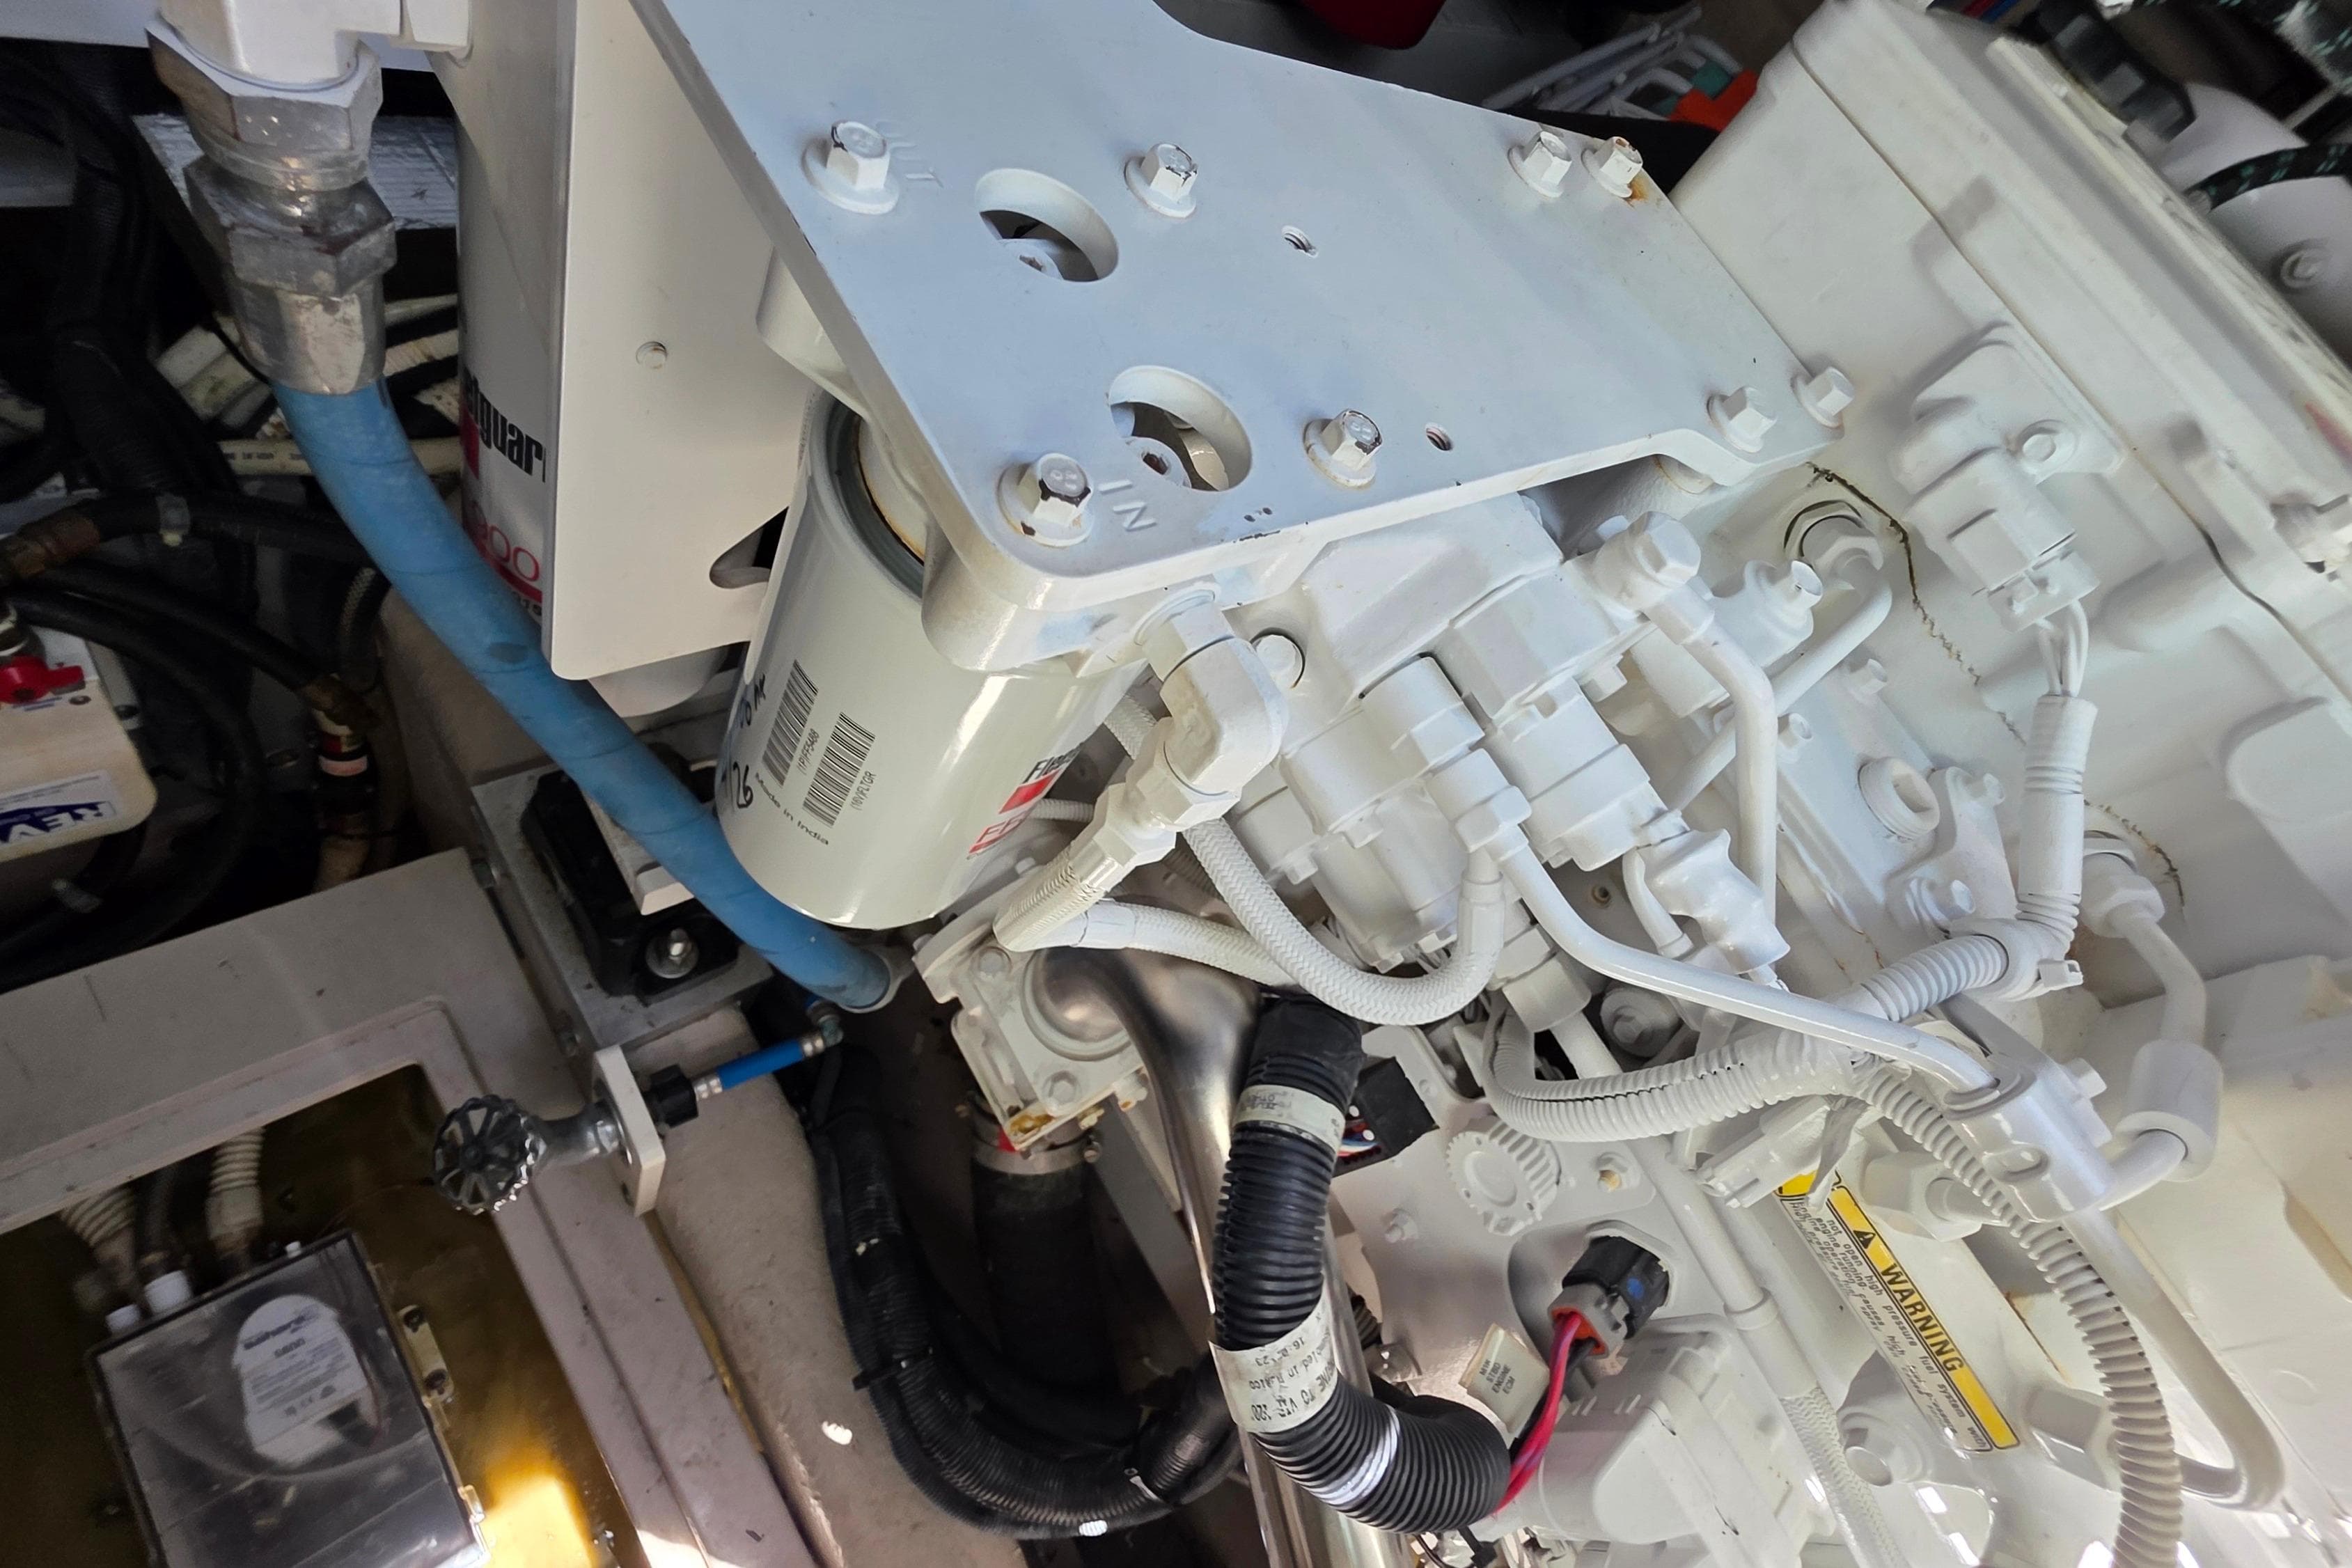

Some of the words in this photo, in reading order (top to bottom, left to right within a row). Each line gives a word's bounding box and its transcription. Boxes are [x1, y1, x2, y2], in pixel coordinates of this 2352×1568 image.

[1098, 478, 1158, 532] IN
[755, 771, 781, 808] Made
[783, 808, 794, 822] in
[797, 820, 829, 845] India
[1814, 1217, 1841, 1248] engine
[1839, 1252, 1868, 1290] running.
[1822, 1241, 1856, 1284] operation
[1858, 1292, 1885, 1326] causes
[1826, 1219, 1843, 1237] not
[1843, 1243, 1864, 1267] open
[1864, 1274, 1884, 1296] high
[1881, 1304, 1918, 1347] pressure
[1919, 1355, 1939, 1374] fuel
[1936, 1383, 1966, 1418] system
[1967, 1426, 1987, 1448] with
[1881, 1262, 1964, 1372] WARNING
[1486, 1363, 1501, 1383] STBD
[1491, 1365, 1511, 1393] ENGINE
